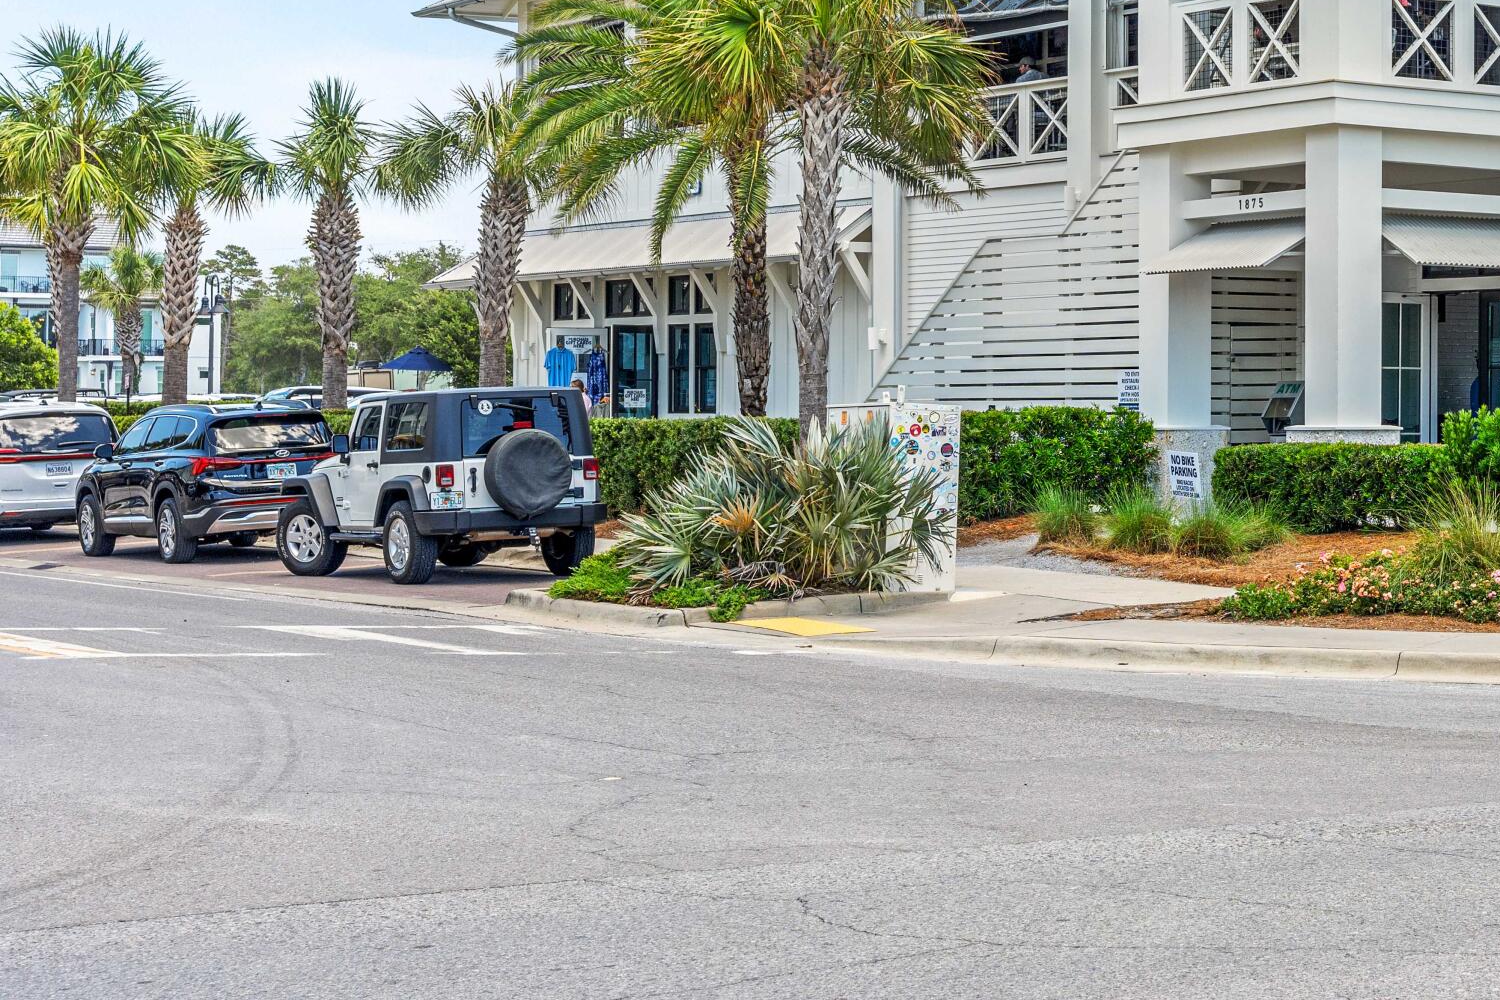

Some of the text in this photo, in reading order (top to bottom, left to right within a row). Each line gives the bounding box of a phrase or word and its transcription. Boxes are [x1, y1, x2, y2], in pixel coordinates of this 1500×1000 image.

[1238, 197, 1264, 211] 1875
[1276, 383, 1302, 394] ATM
[1170, 454, 1195, 467] NO BIKE
[1170, 465, 1198, 478] PARKING
